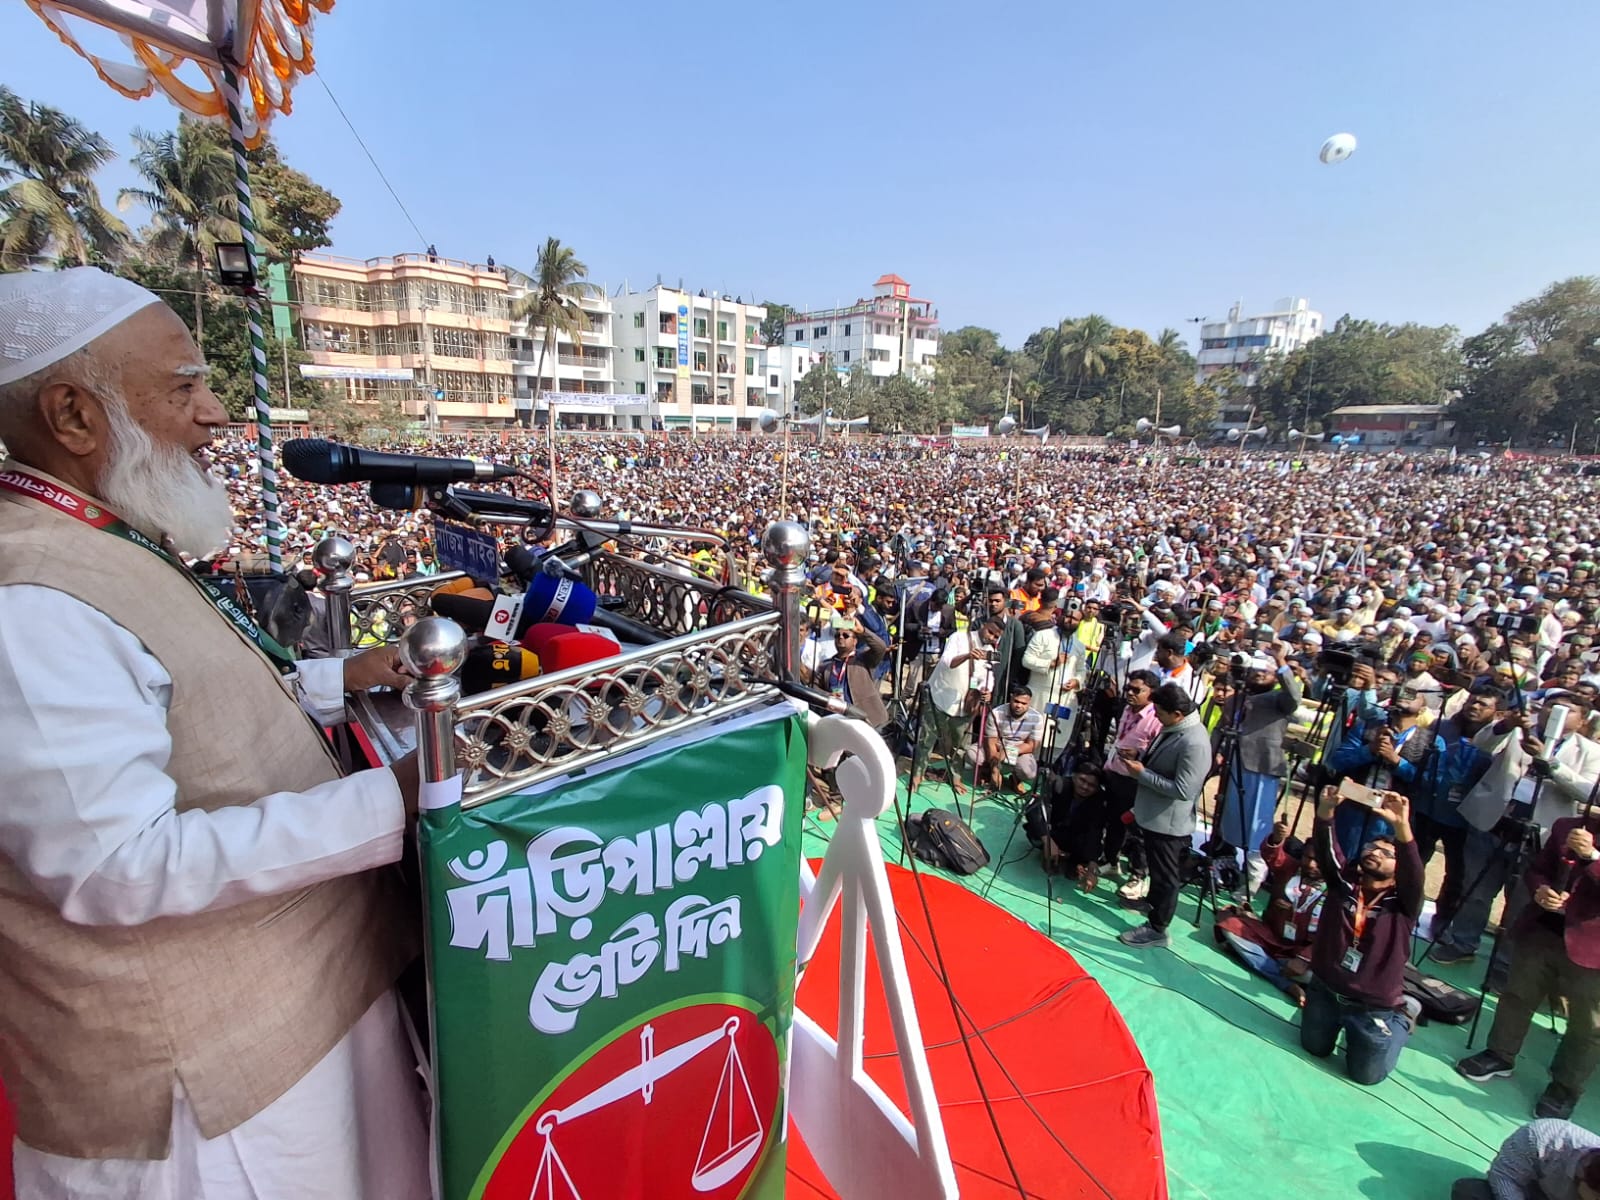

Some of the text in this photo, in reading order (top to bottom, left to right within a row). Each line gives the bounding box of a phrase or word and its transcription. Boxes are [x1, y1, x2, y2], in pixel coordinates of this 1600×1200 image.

[0, 471, 79, 511] বাংলাদে
[446, 784, 785, 961] দাঁড়িপাল্লায়
[528, 894, 742, 1035] ভোট দিন
